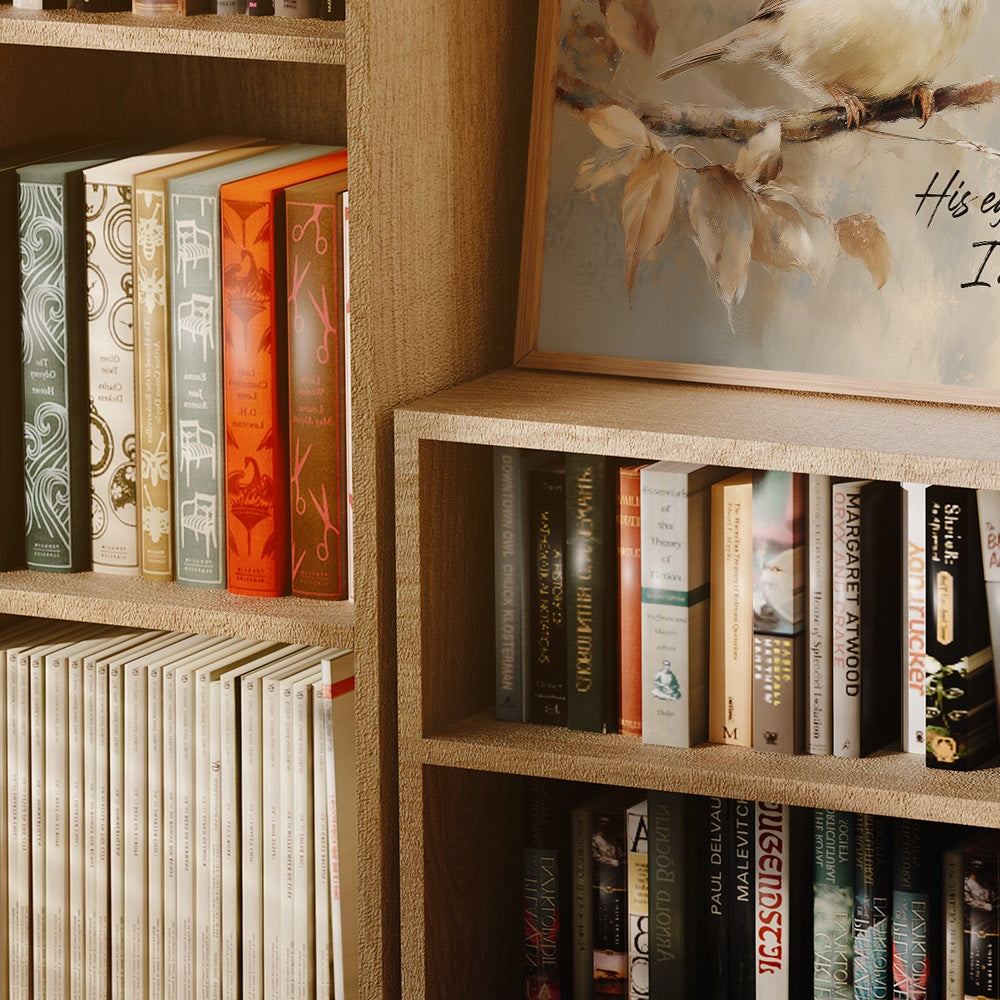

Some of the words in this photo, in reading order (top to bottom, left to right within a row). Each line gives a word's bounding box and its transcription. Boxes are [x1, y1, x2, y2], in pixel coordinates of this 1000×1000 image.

[915, 171, 972, 229] His
[960, 240, 1000, 289] I
[502, 454, 514, 529] DOWNTOWN
[651, 537, 682, 549] Theory
[834, 491, 846, 544] ORYX
[502, 530, 513, 558] OWL
[846, 493, 860, 606] MARGARET
[502, 563, 513, 606] CHUCK
[834, 550, 846, 598] AND
[502, 609, 514, 691] KLOSTERMAN
[834, 601, 846, 669] CRAKE
[846, 611, 860, 698] ATWOOD
[811, 641, 822, 689] Splendid
[710, 871, 722, 916] PAUL
